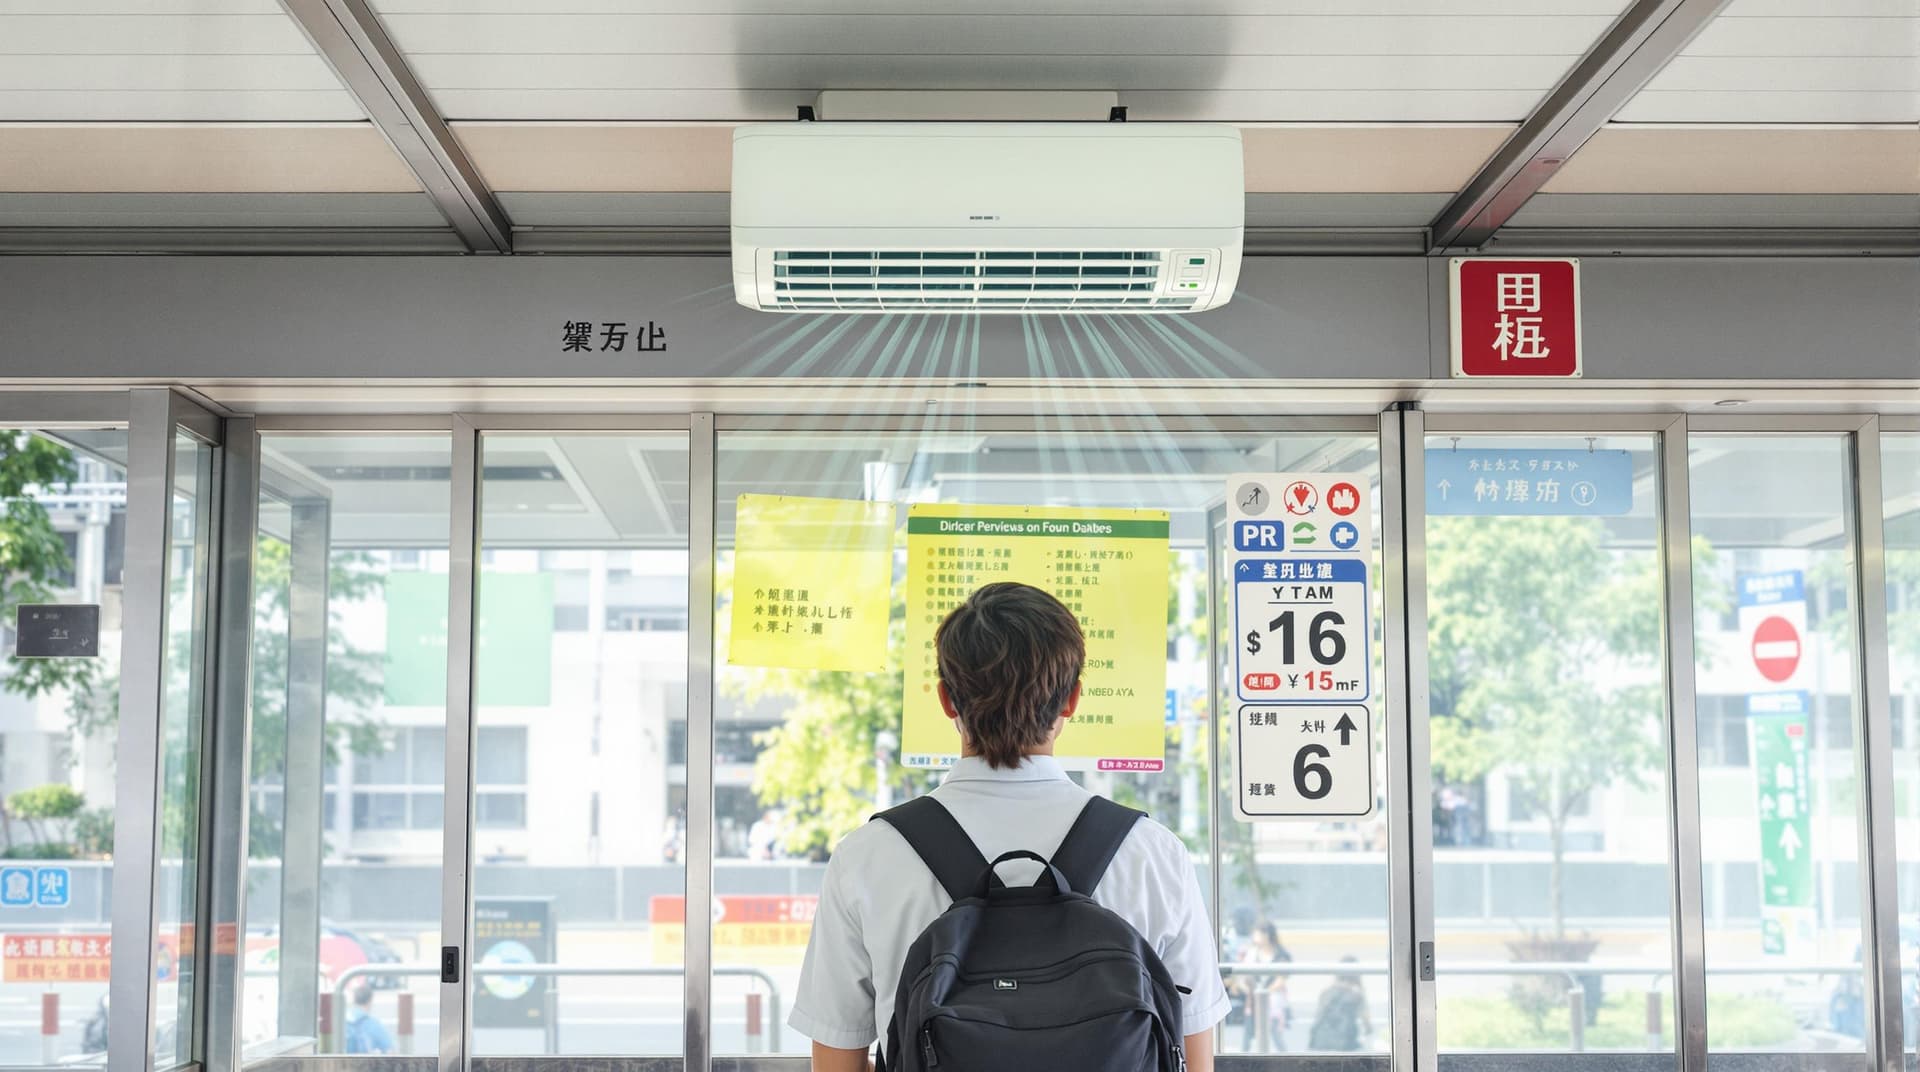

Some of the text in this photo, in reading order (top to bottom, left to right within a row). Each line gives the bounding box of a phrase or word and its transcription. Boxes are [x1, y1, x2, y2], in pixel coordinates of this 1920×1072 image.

[1026, 523, 1040, 533] on
[1042, 521, 1069, 533] Foun
[1242, 525, 1278, 547] PR
[1293, 743, 1333, 800] 6
